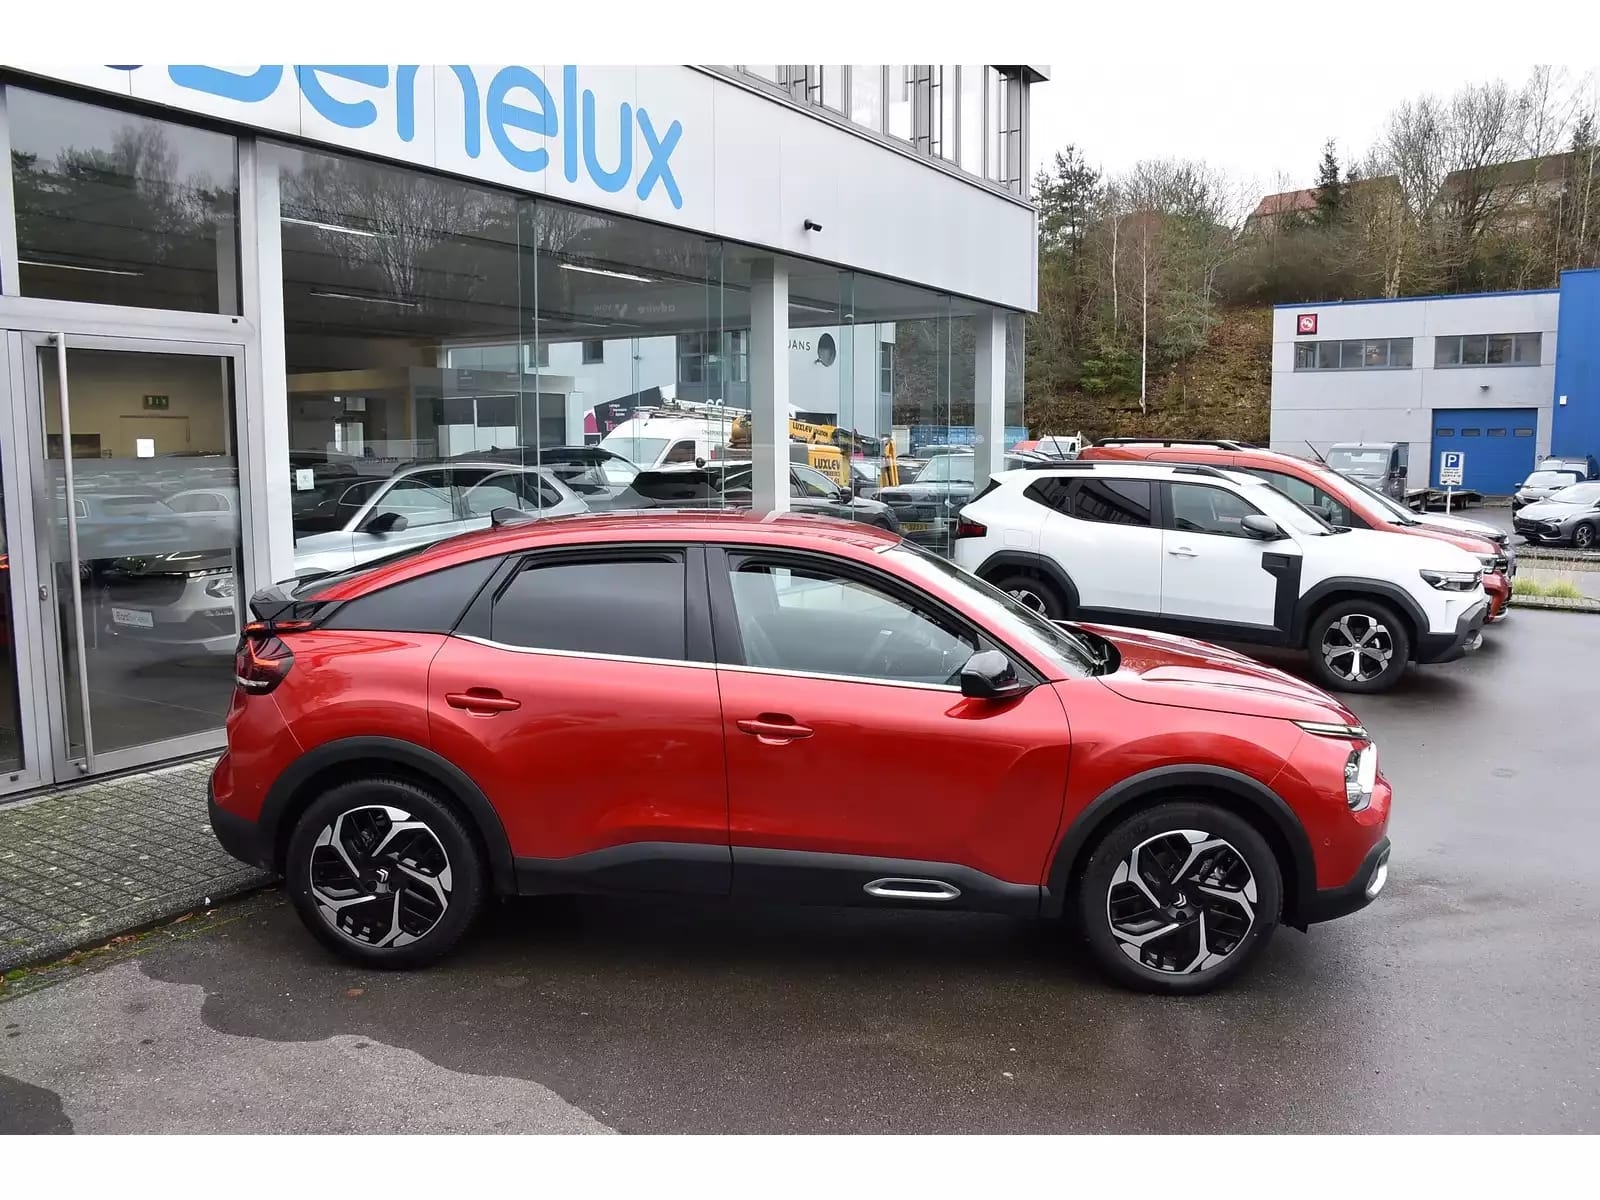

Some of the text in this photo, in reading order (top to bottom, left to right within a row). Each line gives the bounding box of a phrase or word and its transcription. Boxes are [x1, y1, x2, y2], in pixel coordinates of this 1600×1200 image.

[167, 65, 682, 209] enelux
[814, 458, 840, 470] LUXLEV
[1447, 454, 1457, 467] P
